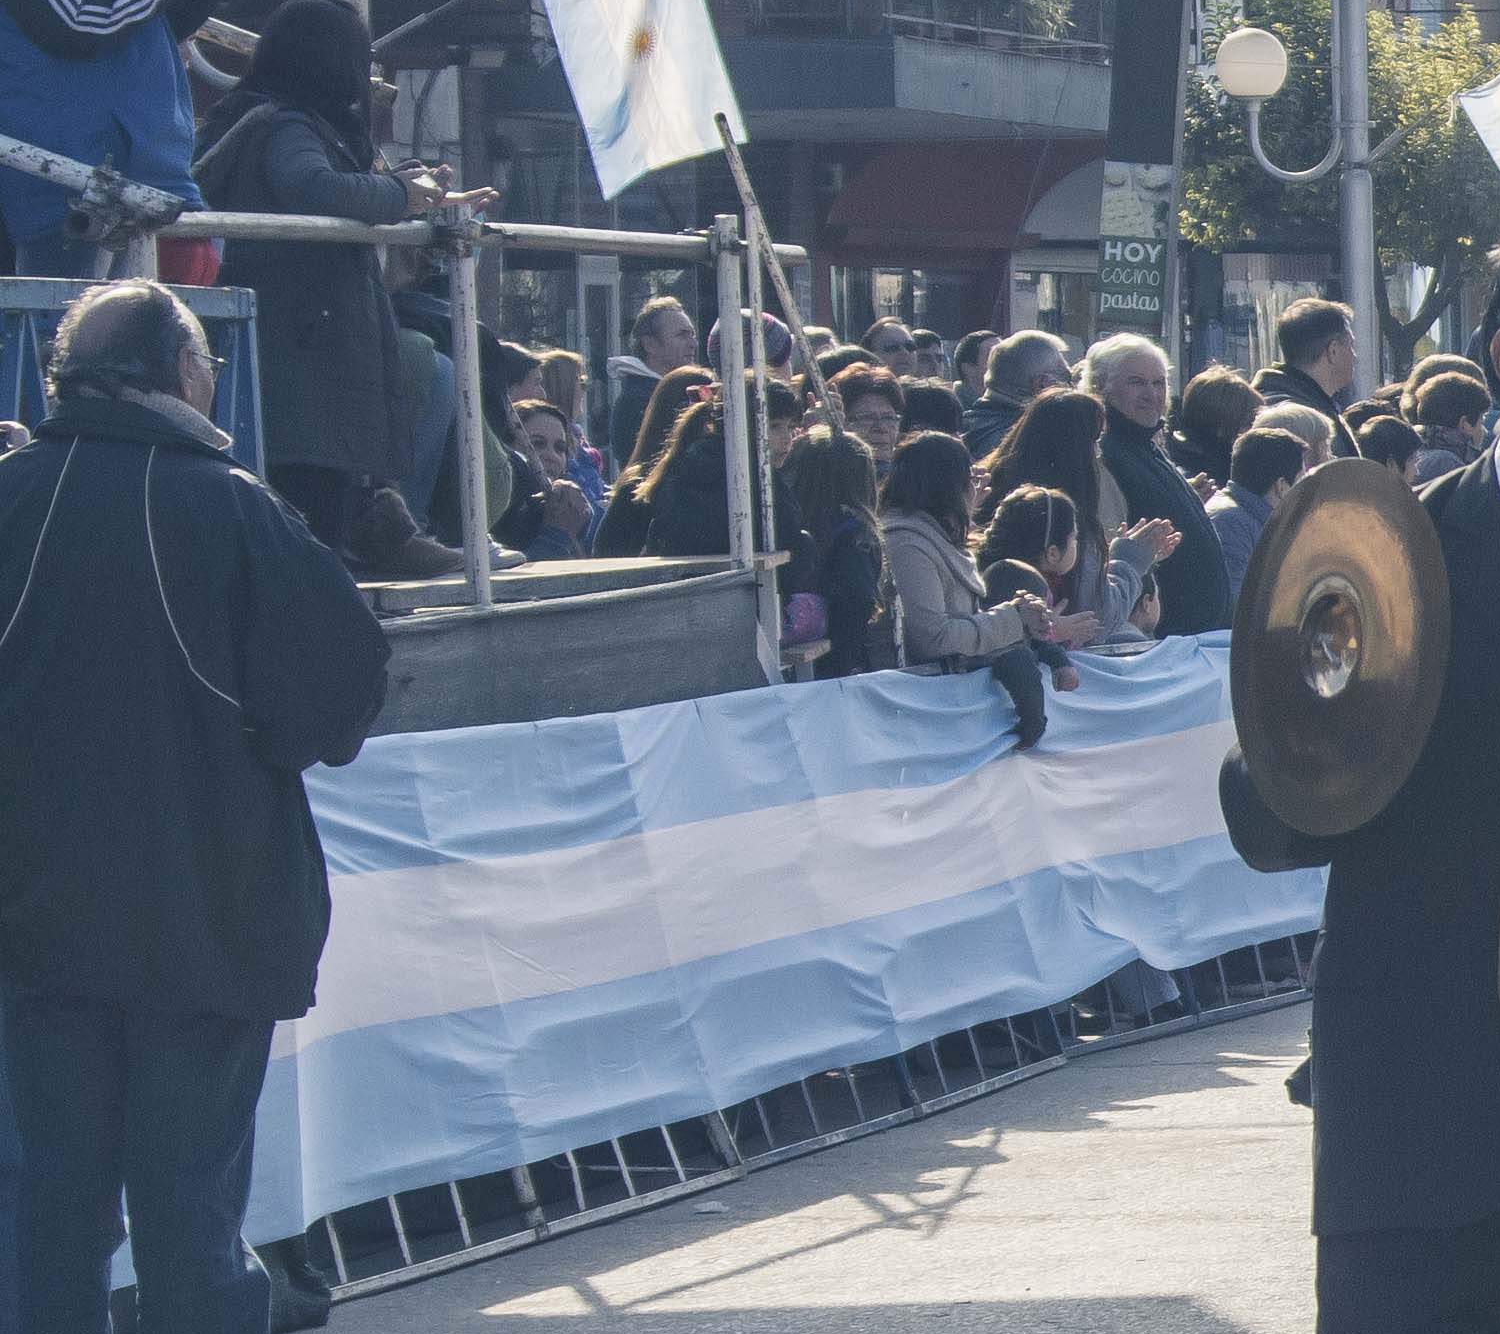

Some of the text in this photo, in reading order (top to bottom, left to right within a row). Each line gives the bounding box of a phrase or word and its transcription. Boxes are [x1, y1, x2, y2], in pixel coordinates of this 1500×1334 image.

[1104, 241, 1162, 263] HOY
[1101, 268, 1160, 285] cocino
[1100, 291, 1159, 313] pastas
